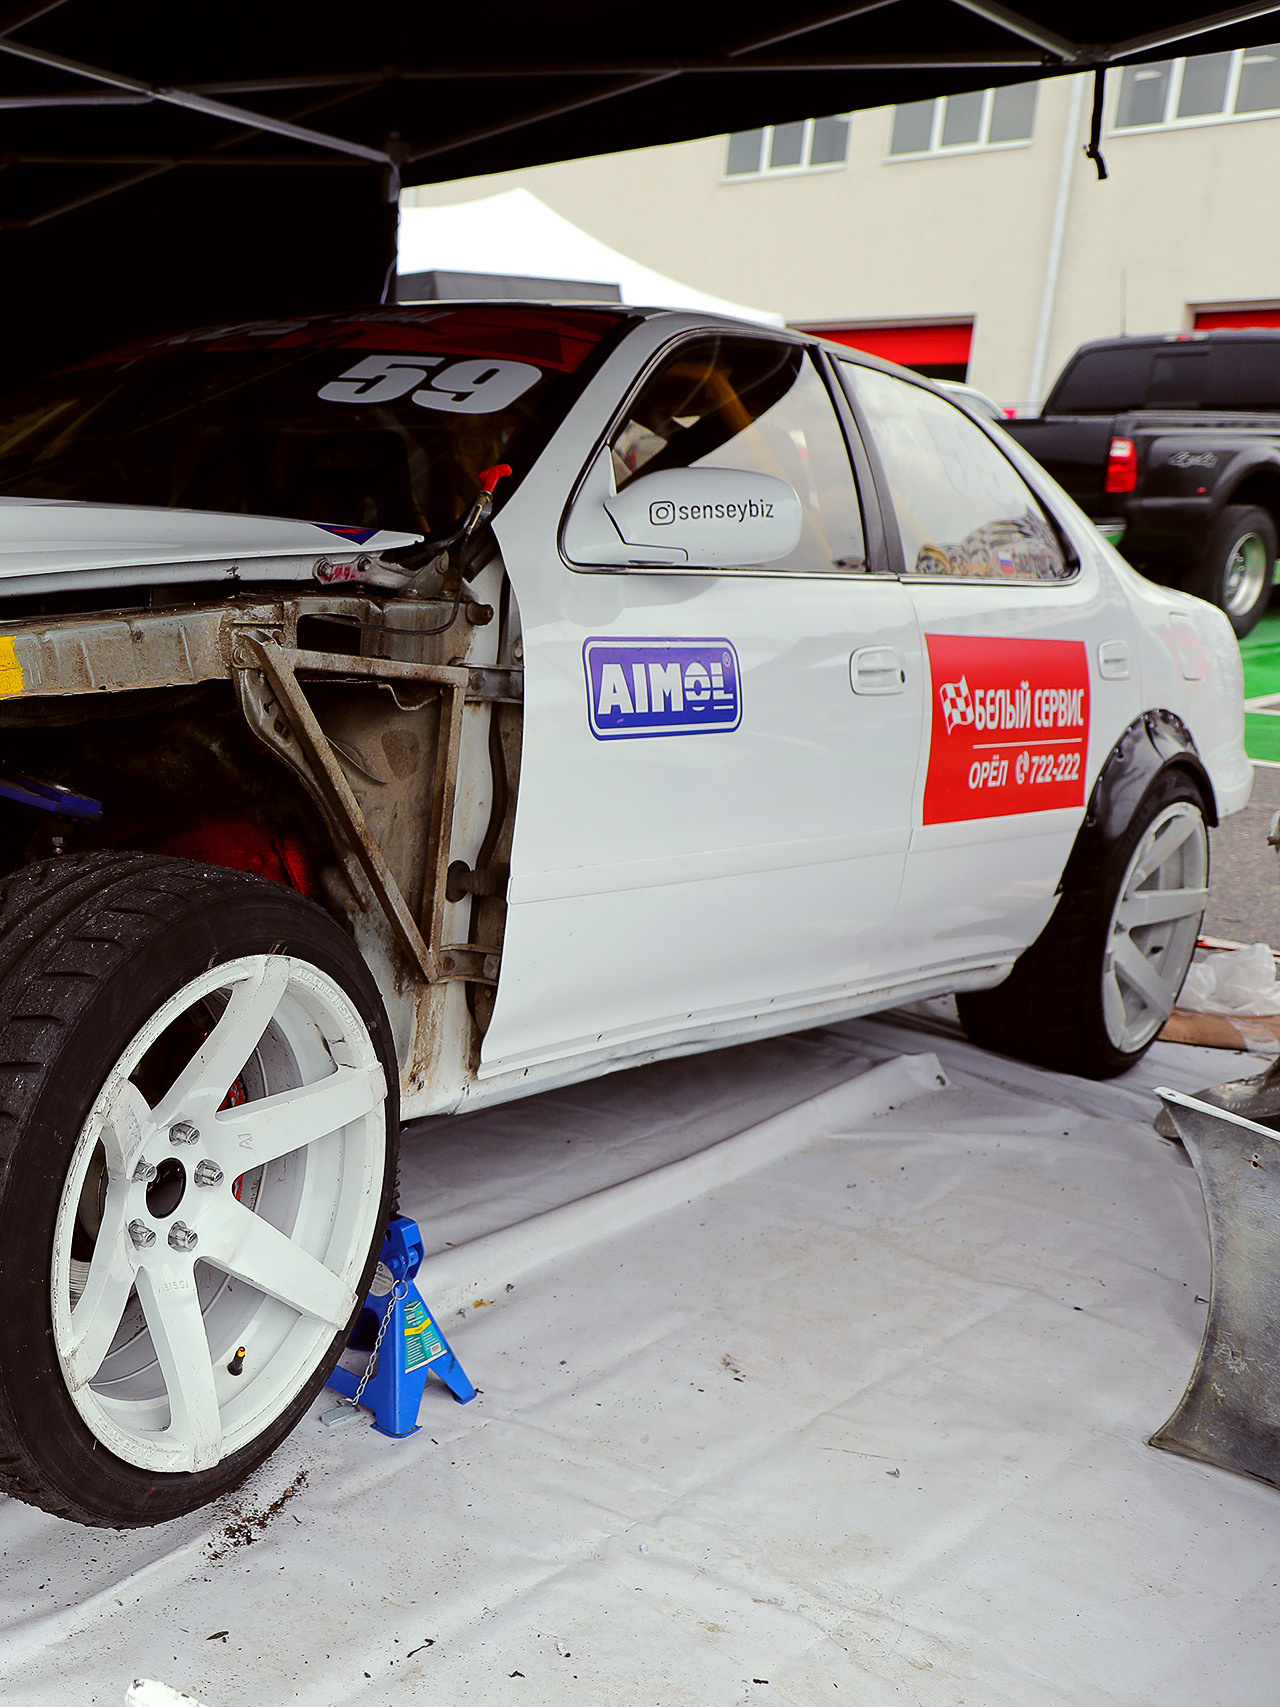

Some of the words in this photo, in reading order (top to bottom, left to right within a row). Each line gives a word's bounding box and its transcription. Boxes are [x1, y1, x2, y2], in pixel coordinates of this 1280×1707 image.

[318, 355, 542, 414] 59
[679, 499, 775, 523] senseybiz
[598, 661, 735, 715] AIMOL
[974, 680, 1031, 730] БЕЛЫЙ
[1034, 688, 1085, 728] СЕРВИС
[969, 754, 1009, 789] ОРЁЛ
[1029, 753, 1081, 784] 722-222
